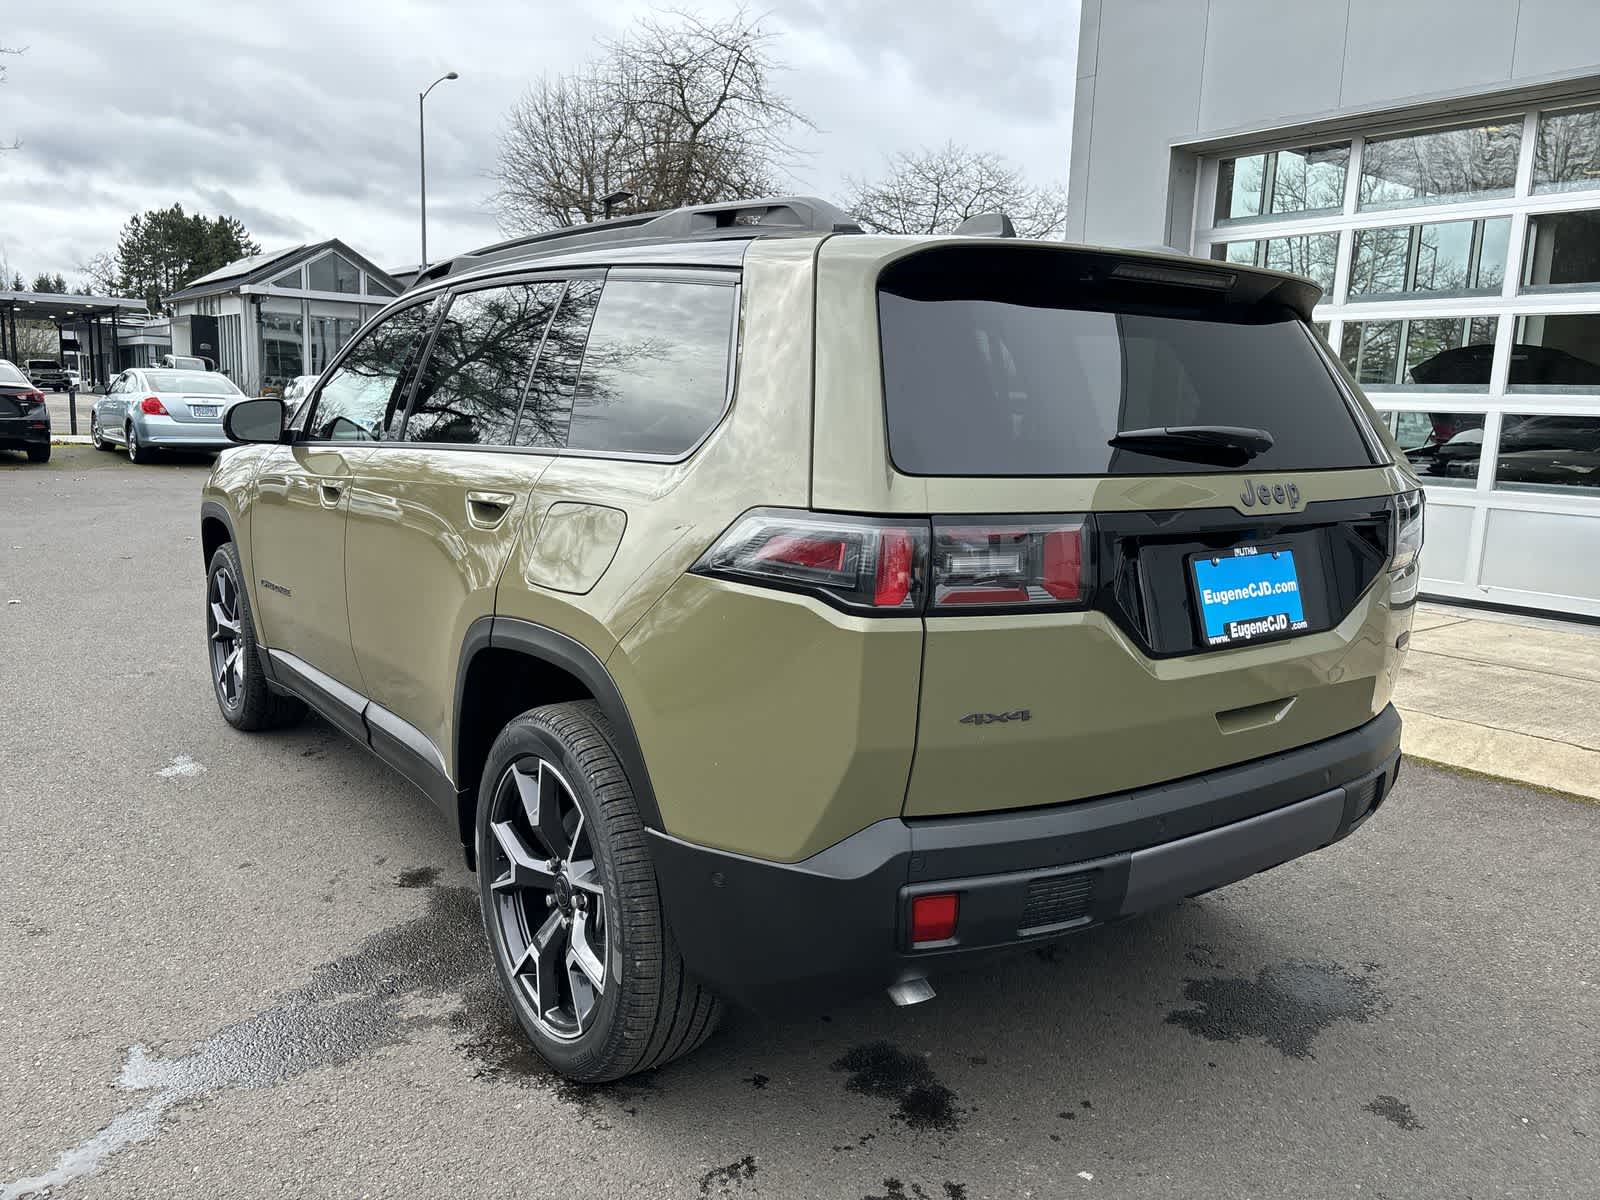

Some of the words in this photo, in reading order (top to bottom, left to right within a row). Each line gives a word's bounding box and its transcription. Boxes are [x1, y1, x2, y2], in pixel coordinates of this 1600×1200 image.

[1240, 479, 1300, 509] Jeep
[1202, 580, 1298, 605] EugeneCJD.com
[1230, 614, 1288, 639] EugeneCJD
